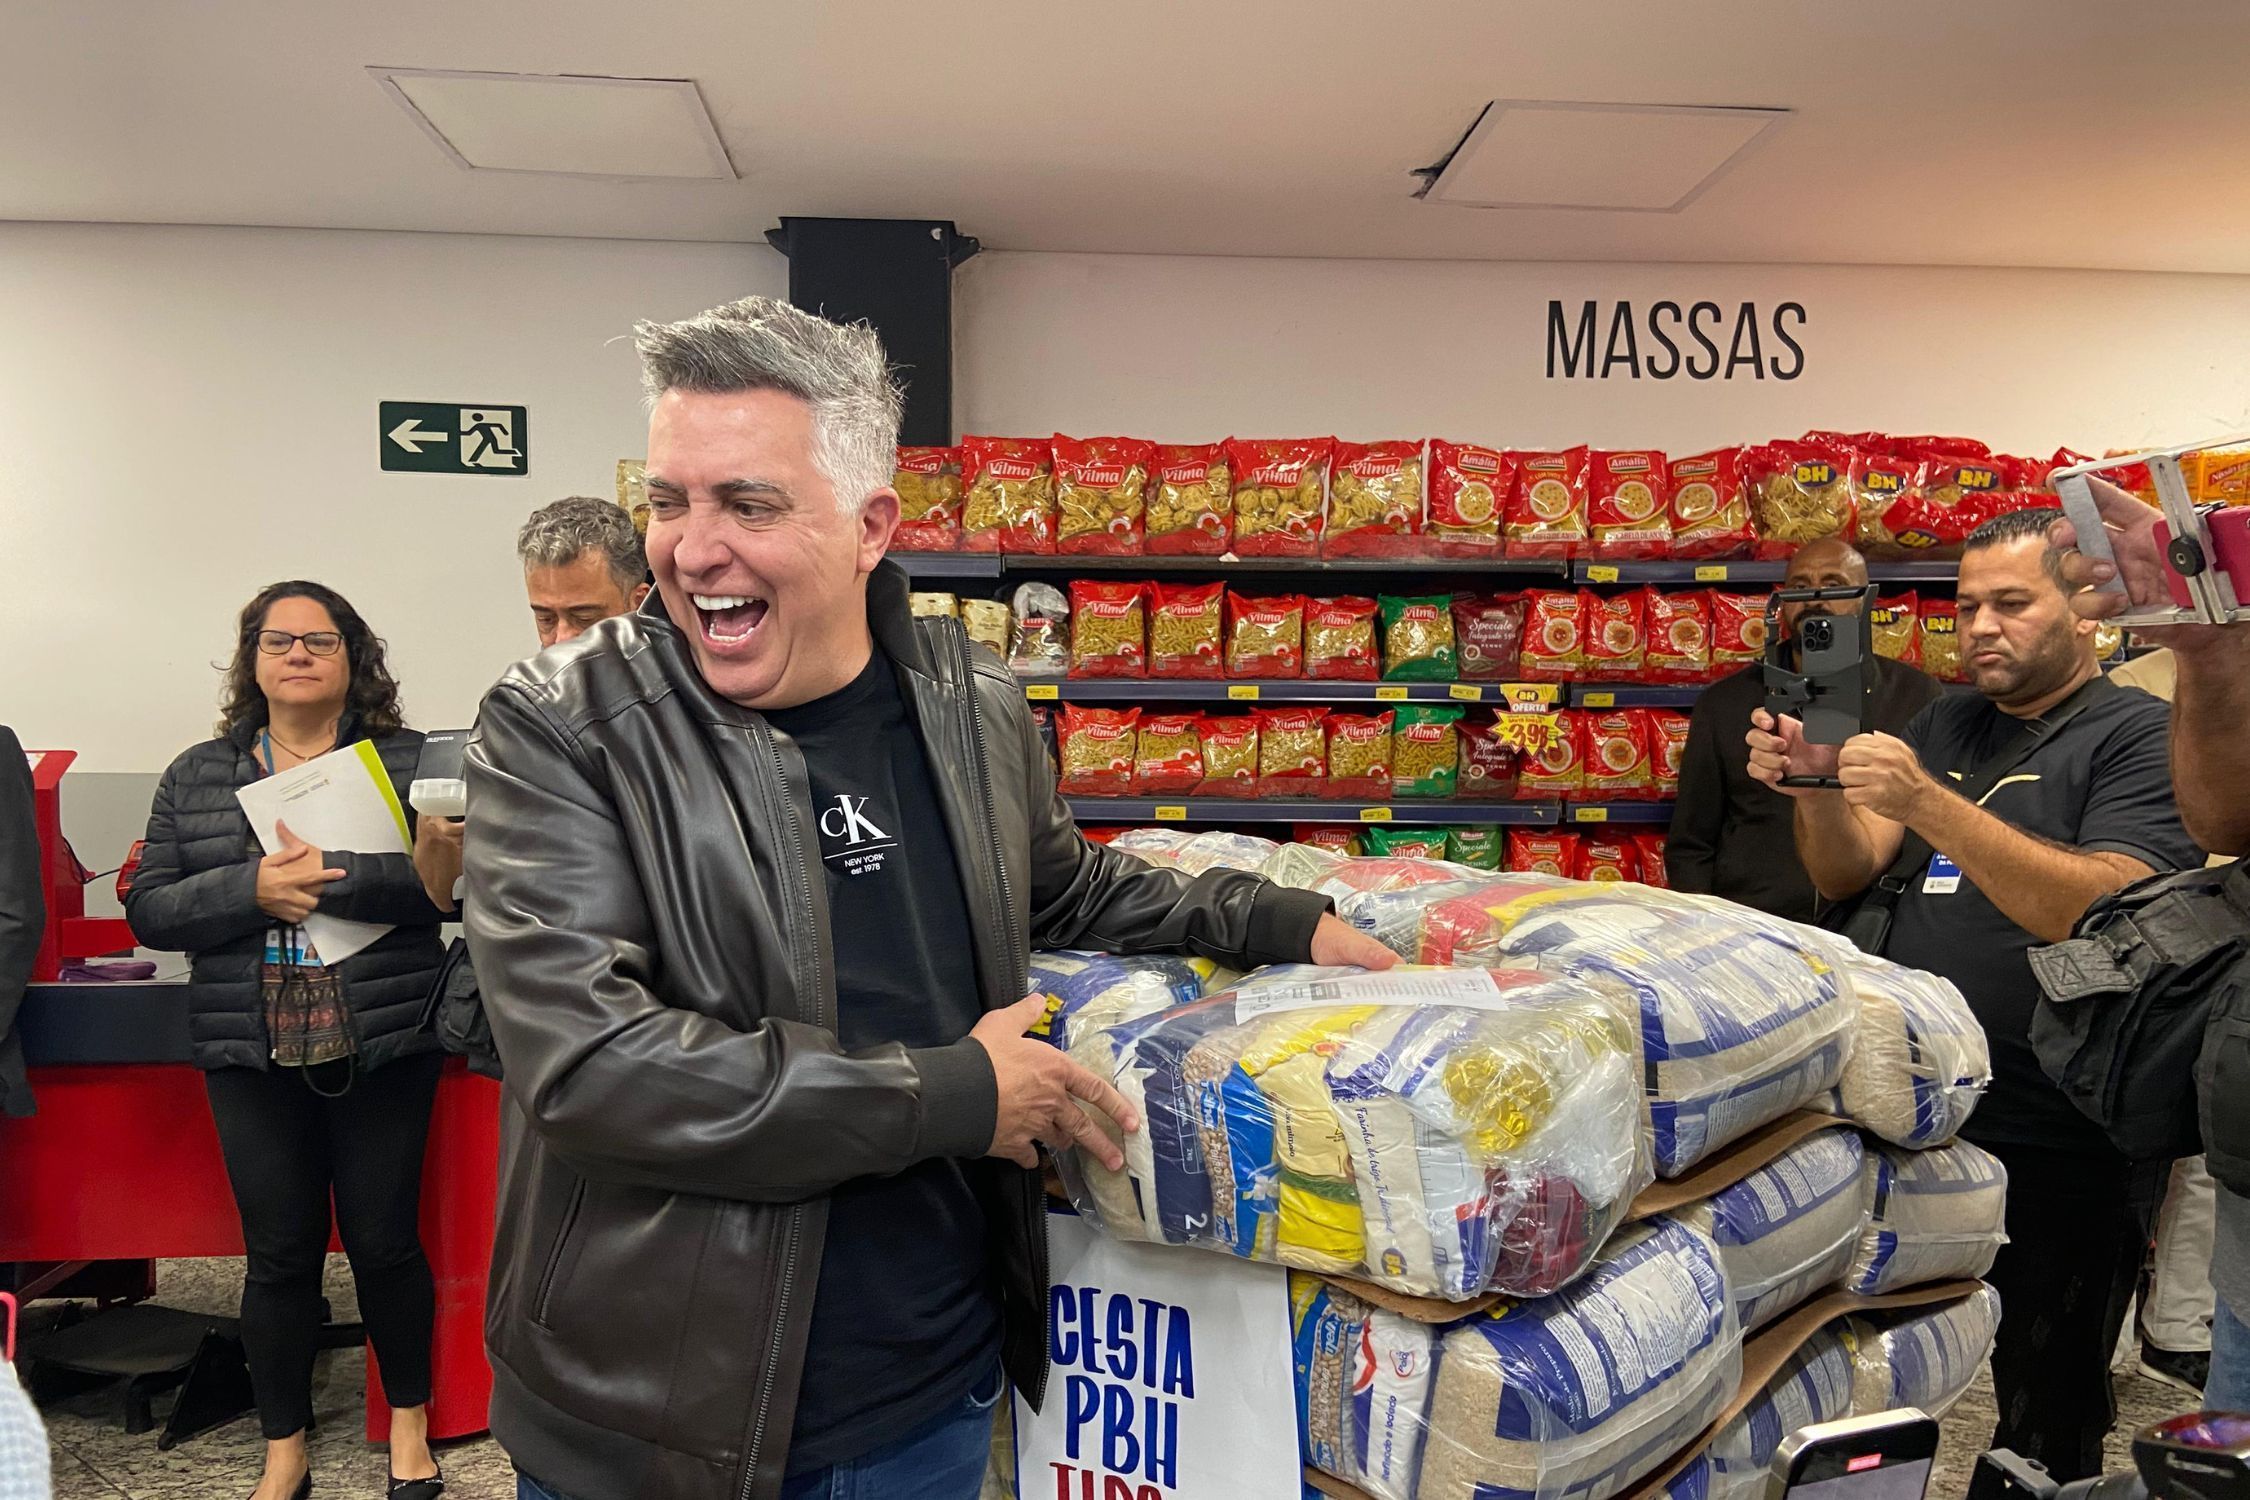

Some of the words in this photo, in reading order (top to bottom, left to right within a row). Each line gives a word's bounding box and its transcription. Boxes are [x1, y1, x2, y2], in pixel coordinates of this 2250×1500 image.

[1546, 300, 1807, 380] MASSAS
[1461, 455, 1497, 468] Amália
[1611, 455, 1648, 467] Amália
[989, 461, 1031, 477] Vilma
[1165, 466, 1205, 482] Vilma
[1352, 462, 1396, 477] Vilma
[1796, 465, 1829, 483] BH
[1077, 469, 1119, 484] Vilma
[1254, 471, 1298, 485] Vilma
[1867, 471, 1898, 490] BH
[1957, 470, 1992, 488] BH
[1093, 603, 1126, 614] Vilma
[1170, 603, 1203, 614] Vilma
[1405, 607, 1437, 620] Vilma
[1250, 611, 1282, 623] Vilma
[1321, 614, 1352, 626] Vilma
[1871, 610, 1893, 623] BH
[1469, 618, 1513, 632] Speciale
[1926, 618, 1954, 631] BH
[1518, 691, 1536, 701] BH
[1512, 703, 1546, 713] OFERTA
[1150, 724, 1182, 735] Vilma
[1275, 718, 1307, 731] Vilma
[1086, 726, 1118, 738] Vilma
[1343, 725, 1375, 738] Vilma
[1408, 727, 1441, 739] Vilma
[1213, 735, 1241, 745] Vilma
[1314, 832, 1348, 843] Vilma
[1391, 847, 1425, 858] Vilma
[1454, 841, 1492, 855] Speciale
[844, 857, 862, 868] NEW
[863, 853, 885, 864] YORK
[864, 863, 881, 873] 1978
[1177, 1097, 1188, 1127] CRISAL
[1354, 1107, 1374, 1146] Farinha
[1375, 1184, 1396, 1233] Trdicional
[1185, 1213, 1209, 1230] 2
[1050, 1284, 1195, 1400] CESTA
[1066, 1375, 1178, 1490] PBH
[1381, 1439, 1392, 1483] Refinado
